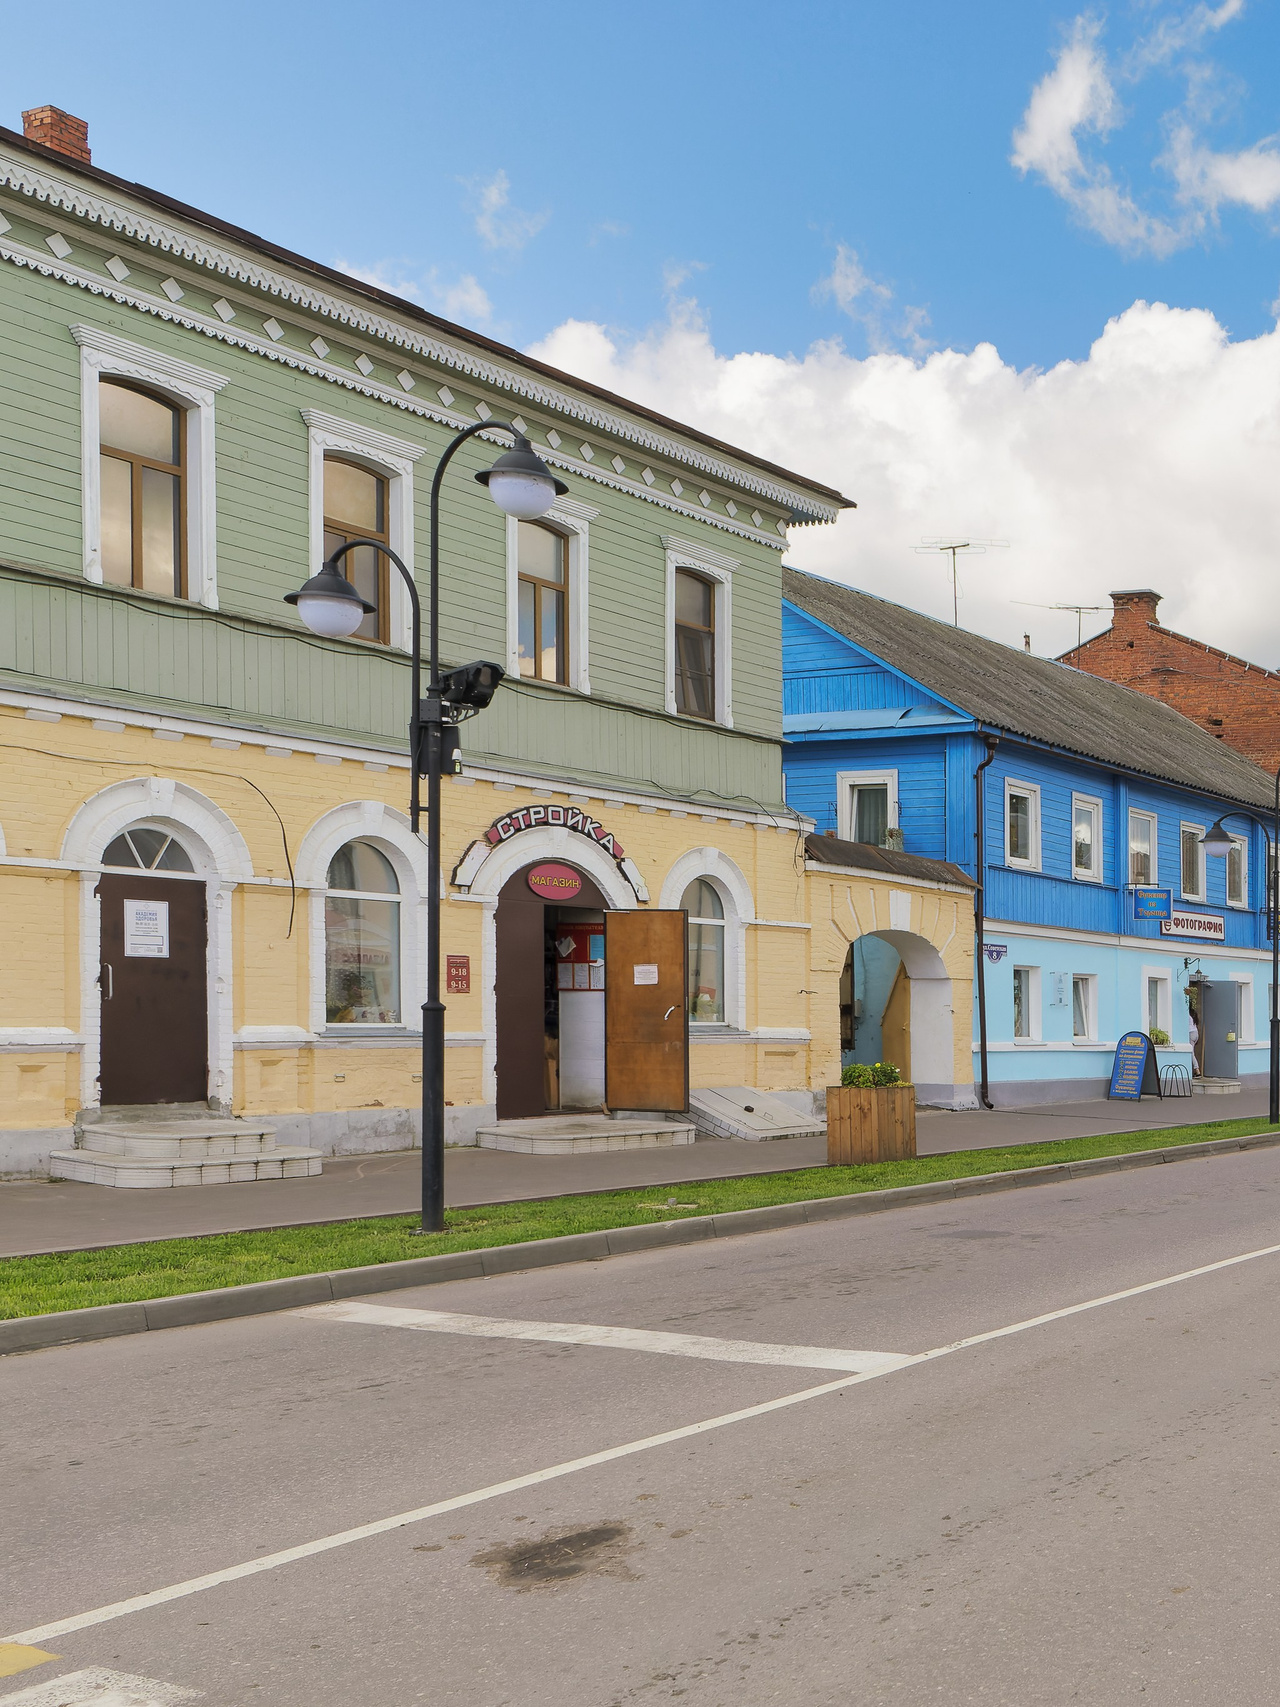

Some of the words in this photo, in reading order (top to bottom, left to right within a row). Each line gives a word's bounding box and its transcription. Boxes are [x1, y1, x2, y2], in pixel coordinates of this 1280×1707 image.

[496, 806, 615, 855] СТРОЙКА
[531, 875, 580, 888] МАГАЗИН
[1173, 917, 1223, 934] ФОТОГРАФИЯ
[992, 951, 998, 960] 8
[450, 967, 467, 976] 9-18
[450, 980, 467, 989] 9-15
